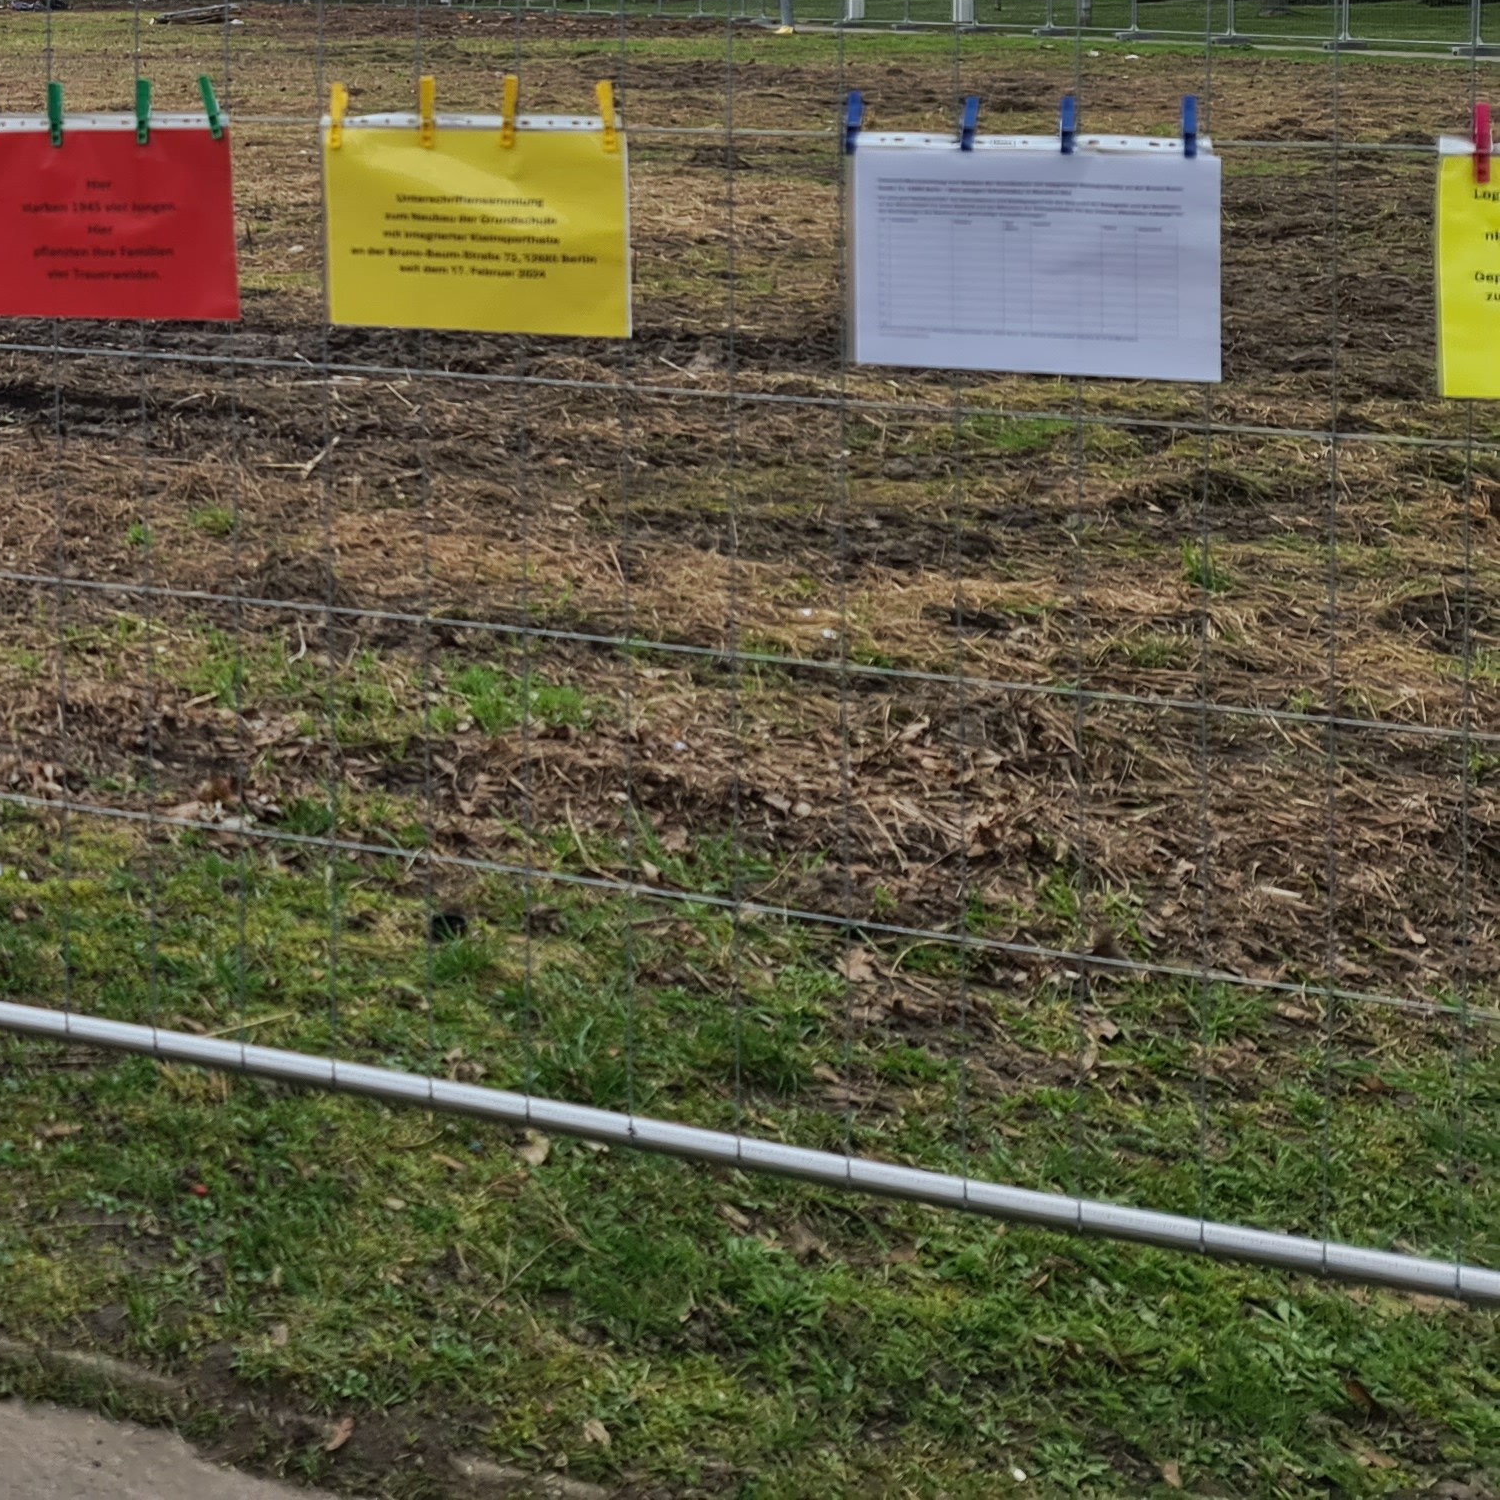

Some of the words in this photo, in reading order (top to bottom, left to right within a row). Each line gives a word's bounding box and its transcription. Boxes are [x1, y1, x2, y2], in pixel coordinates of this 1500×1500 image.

[86, 179, 112, 190] Hier
[458, 212, 478, 224] der
[87, 224, 113, 235] Hier
[367, 246, 385, 257] der
[561, 252, 598, 266] Berlin
